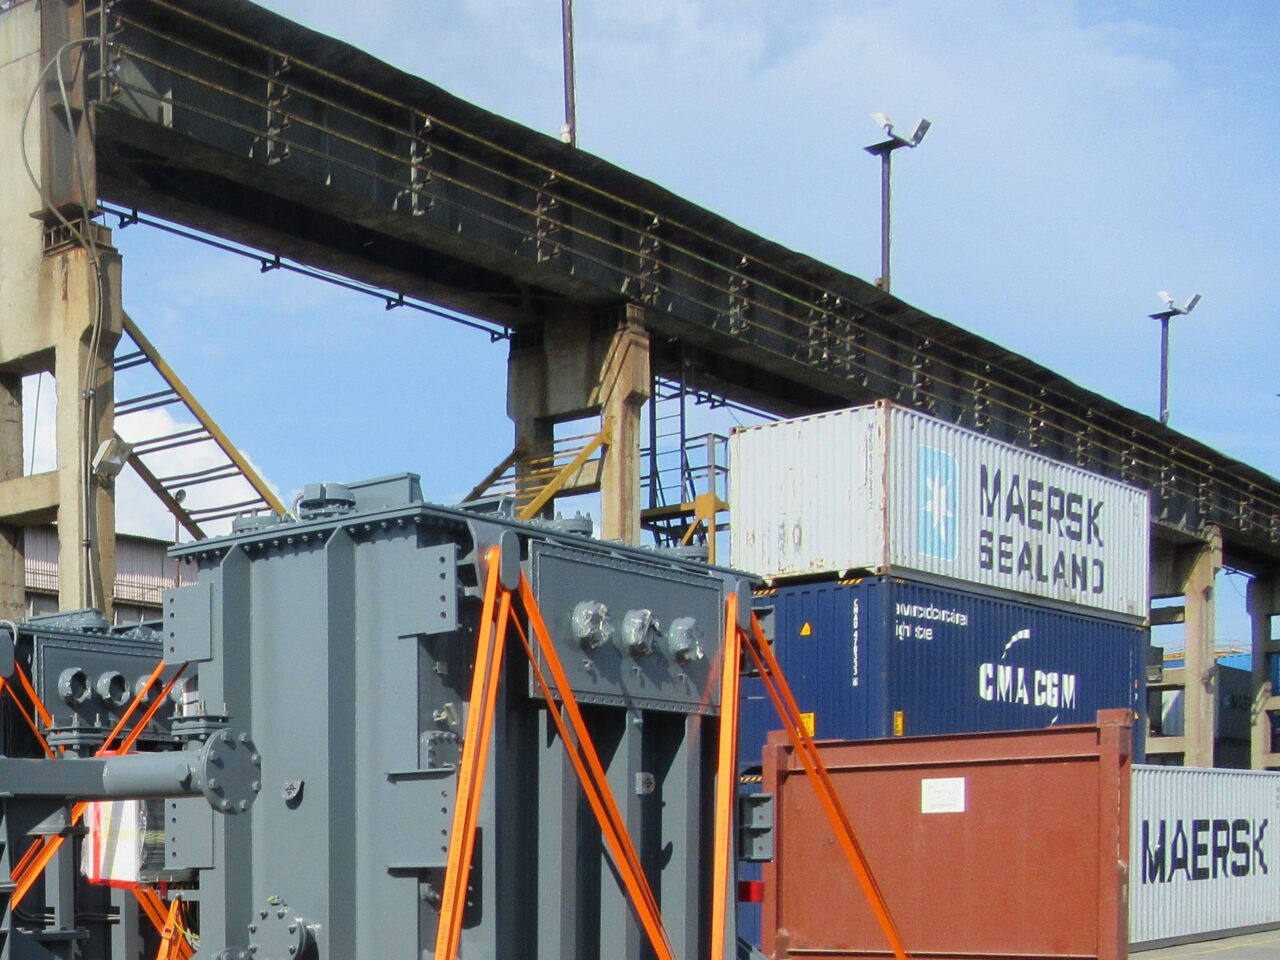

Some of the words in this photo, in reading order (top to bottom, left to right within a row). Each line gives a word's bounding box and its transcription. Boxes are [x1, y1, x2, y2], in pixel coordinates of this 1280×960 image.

[980, 463, 1105, 548] MAERSK
[979, 529, 1105, 595] SEALAND
[979, 662, 1030, 705] CMA
[1141, 818, 1269, 885] MAERSK
